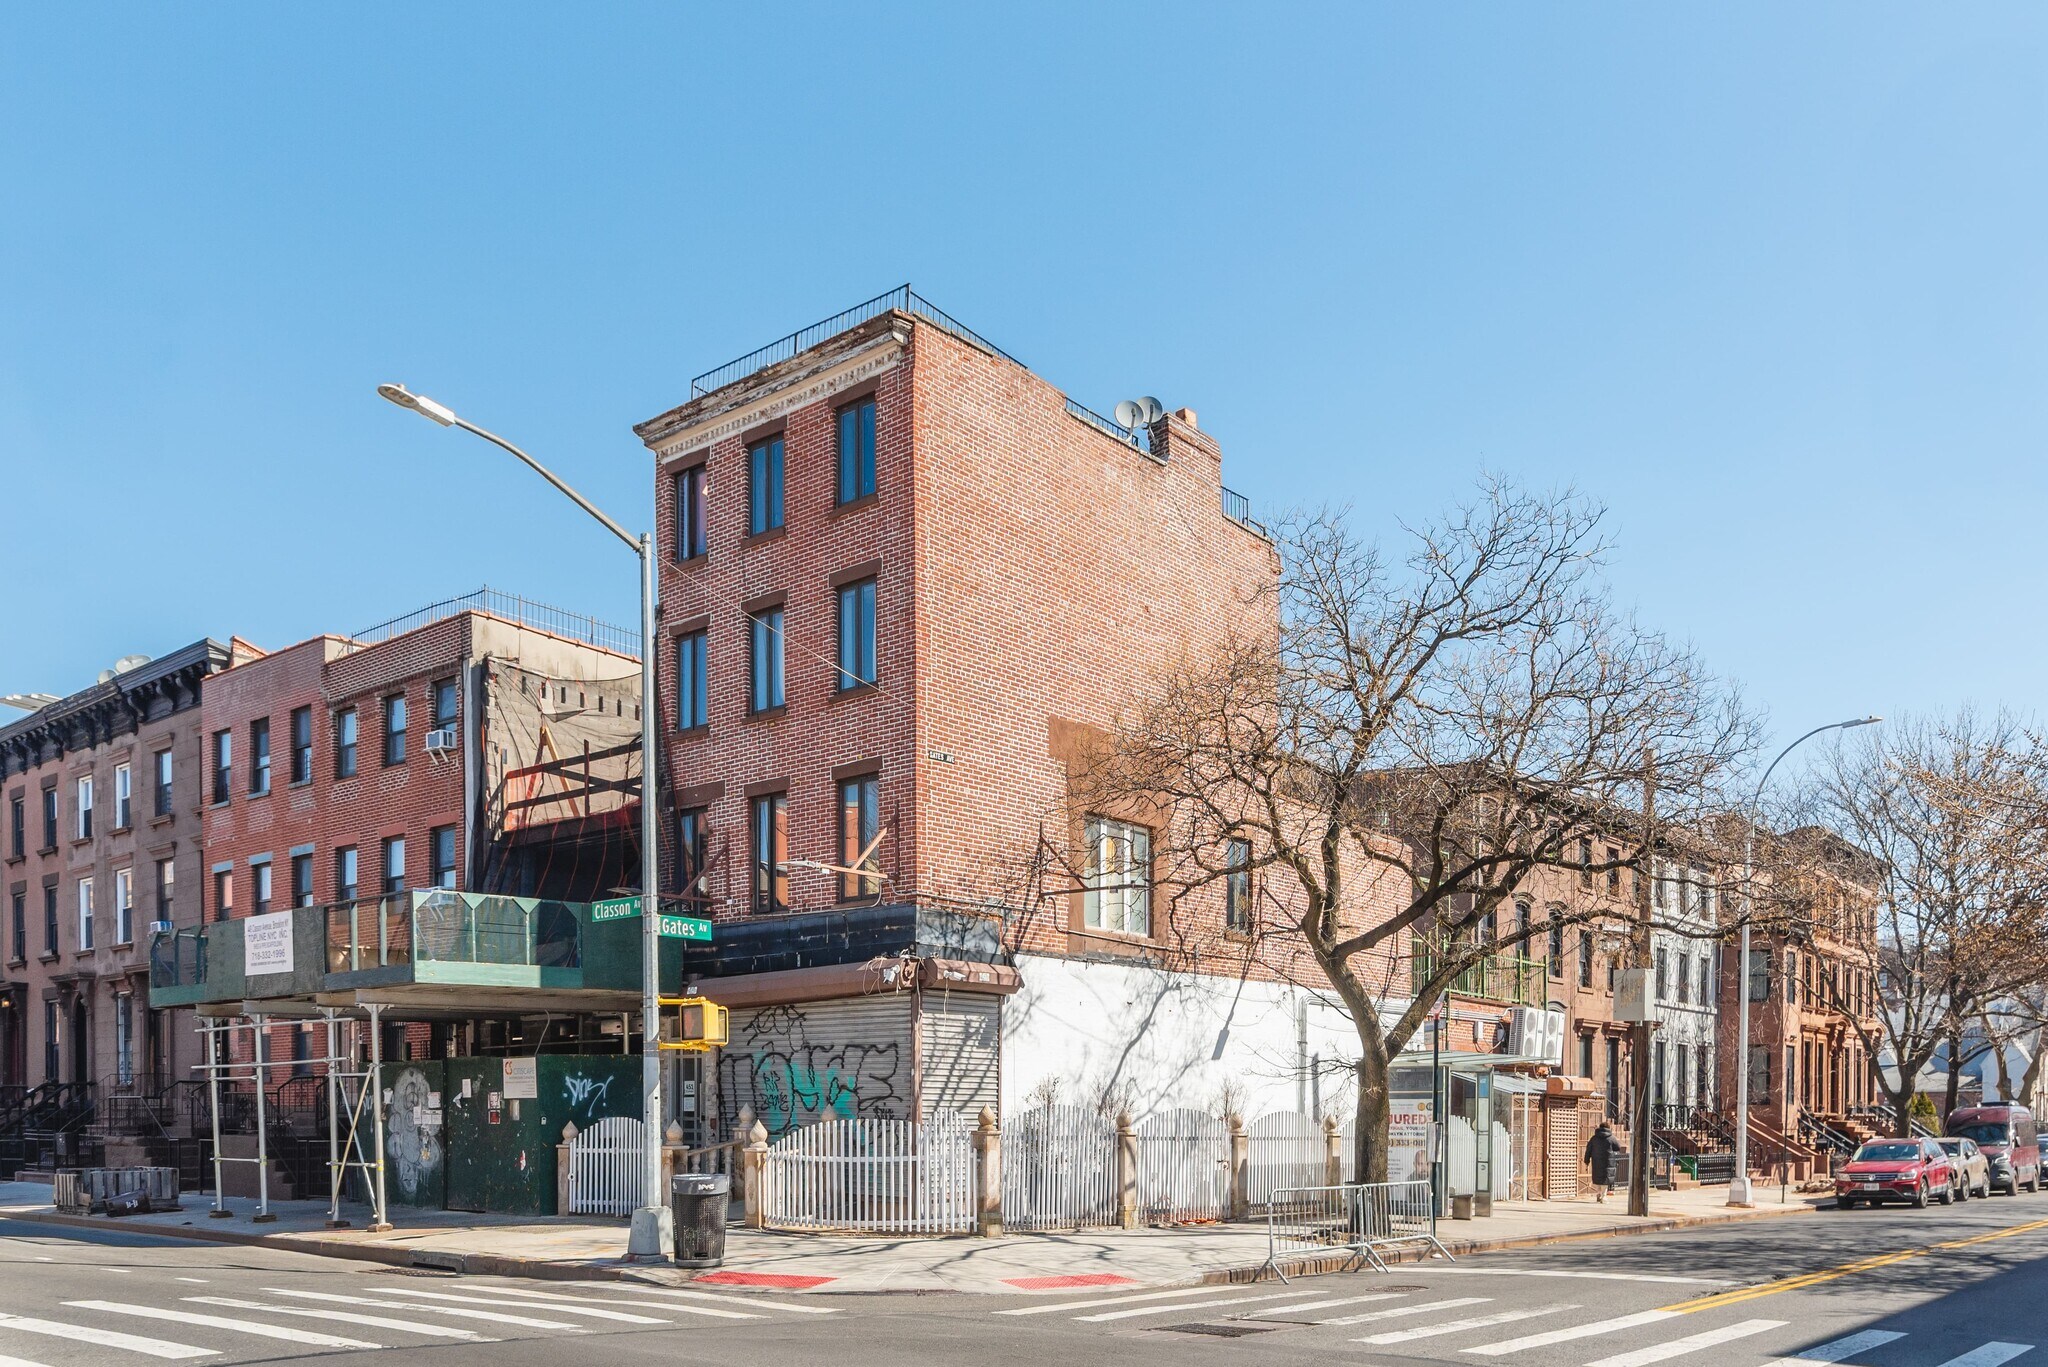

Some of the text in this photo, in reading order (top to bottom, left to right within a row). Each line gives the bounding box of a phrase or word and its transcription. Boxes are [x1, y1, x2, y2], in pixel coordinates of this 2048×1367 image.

[929, 751, 944, 760] GATES
[594, 902, 631, 919] Classon
[662, 919, 695, 936] Gates
[248, 933, 267, 942] TOPLINE
[267, 931, 277, 940] NYC
